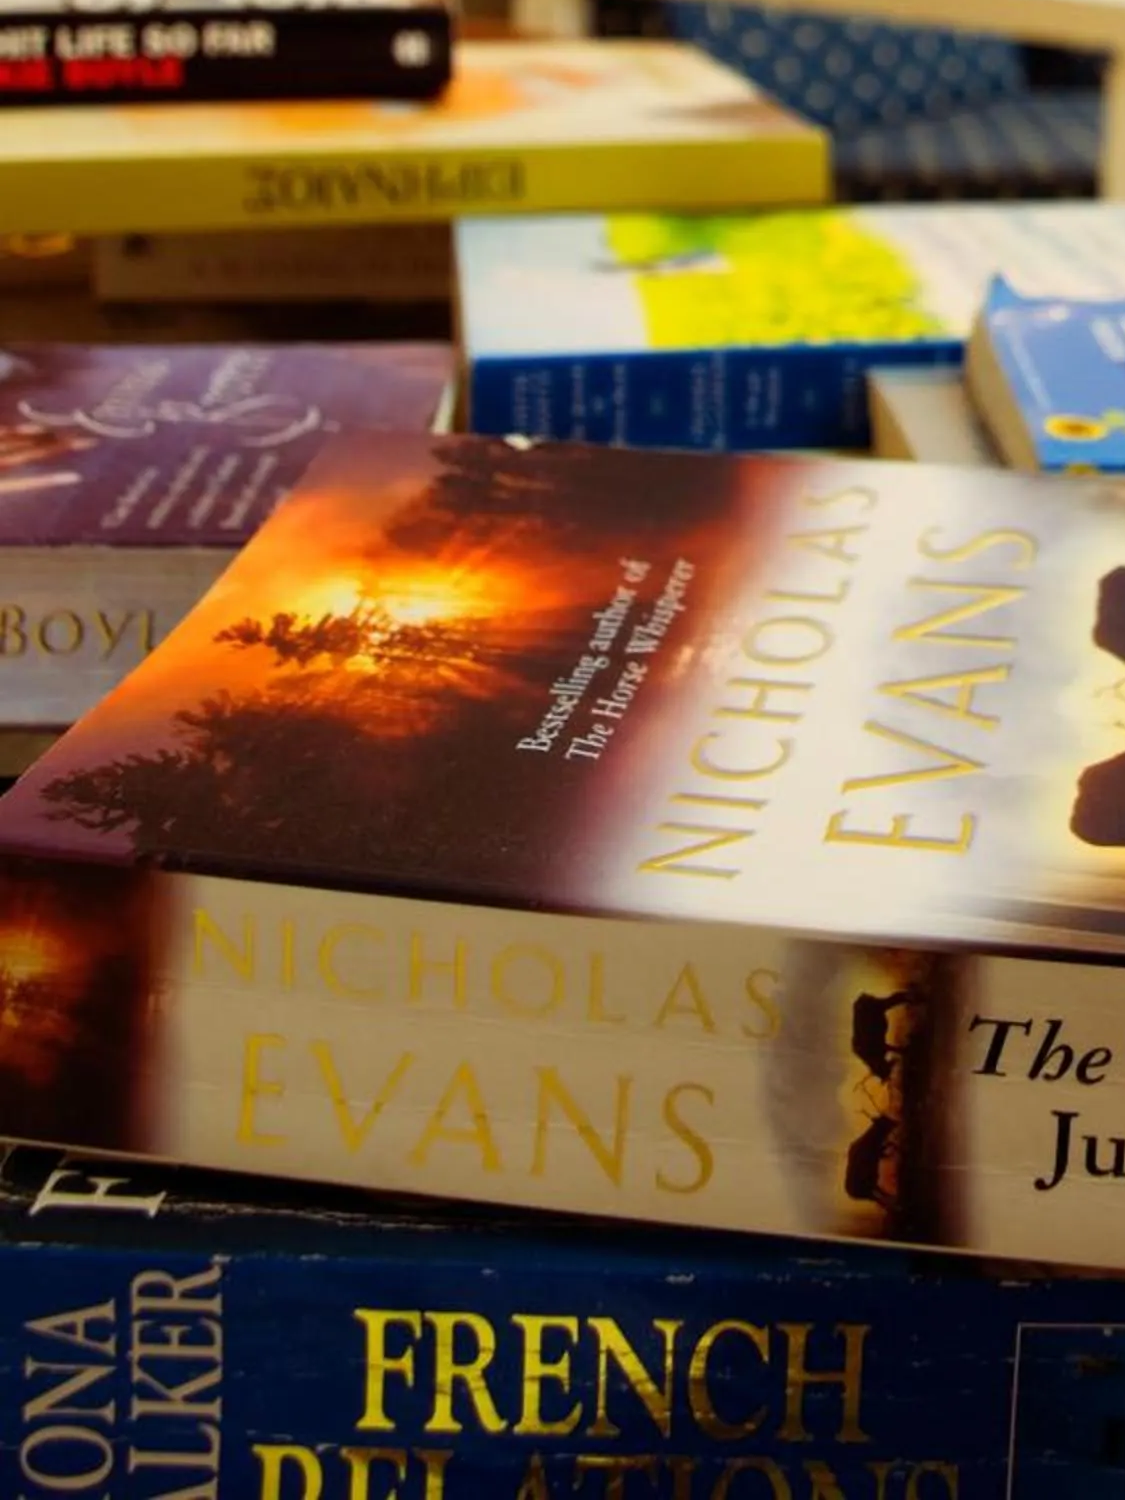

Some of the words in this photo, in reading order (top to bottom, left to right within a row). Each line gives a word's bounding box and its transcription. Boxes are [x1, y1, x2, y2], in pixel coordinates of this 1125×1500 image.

[516, 653, 610, 752] Bestselling
[588, 585, 638, 651] author
[618, 556, 652, 583] of
[564, 723, 615, 760] The
[591, 661, 649, 719] Horse
[624, 556, 697, 655] Whisperer
[636, 483, 878, 880] NICHOLAS
[823, 525, 1039, 856] EVANS
[191, 908, 784, 1041] NICHOLAS
[967, 1014, 1114, 1087] The
[234, 1032, 717, 1195] EVANS
[20, 1298, 117, 1500] ONA
[352, 1307, 874, 1444] FRENCH
